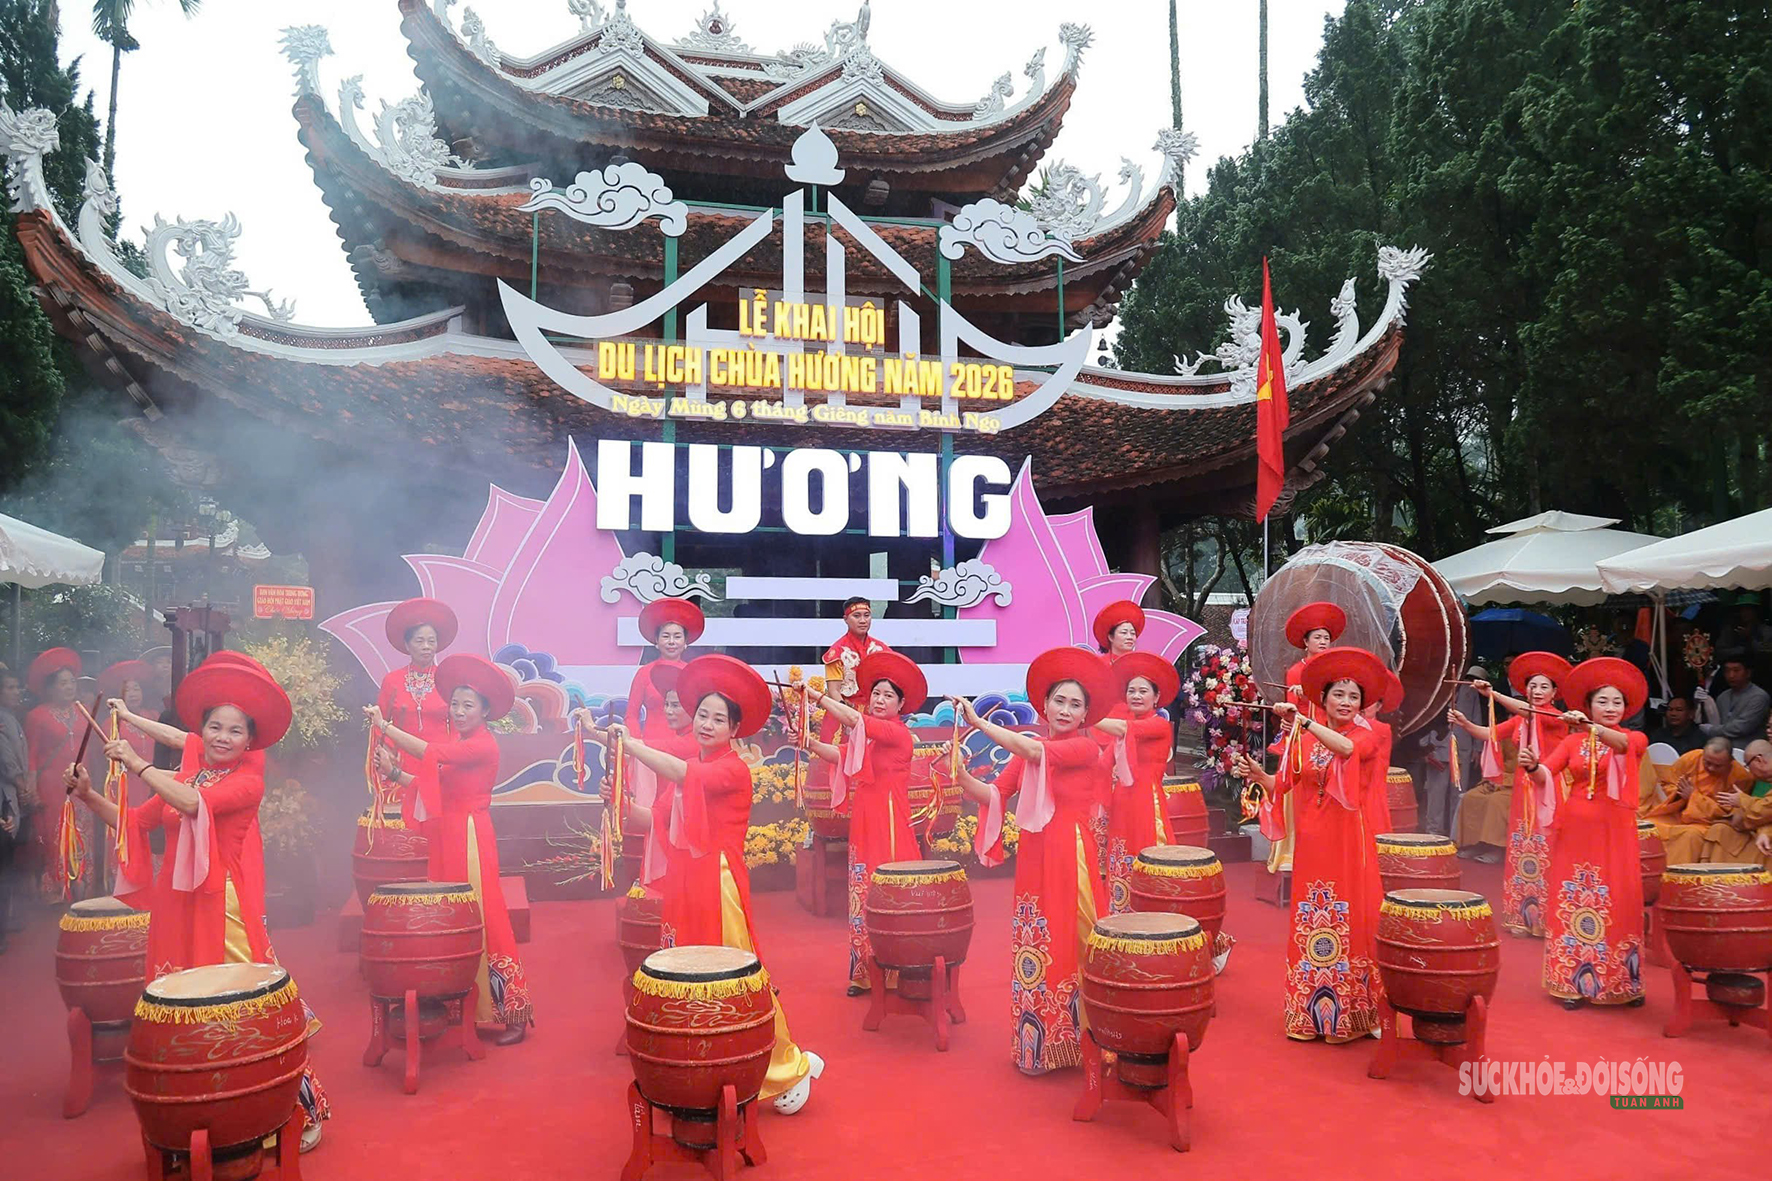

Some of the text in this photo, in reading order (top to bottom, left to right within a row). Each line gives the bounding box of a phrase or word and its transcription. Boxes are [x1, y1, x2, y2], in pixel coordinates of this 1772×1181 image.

[739, 288, 885, 351] LỄ KHAI HỘI
[599, 342, 1014, 400] DU LỊCH CHÙA HƯƠNG NĂM 2026
[612, 395, 664, 417] Ngày
[732, 400, 747, 418] 6
[751, 400, 808, 423] tháng
[813, 404, 869, 426] Giêng
[873, 410, 912, 425] năm
[919, 409, 961, 428] Bính
[964, 413, 1001, 434] Ngọ
[596, 439, 1012, 540] HƯƠNG
